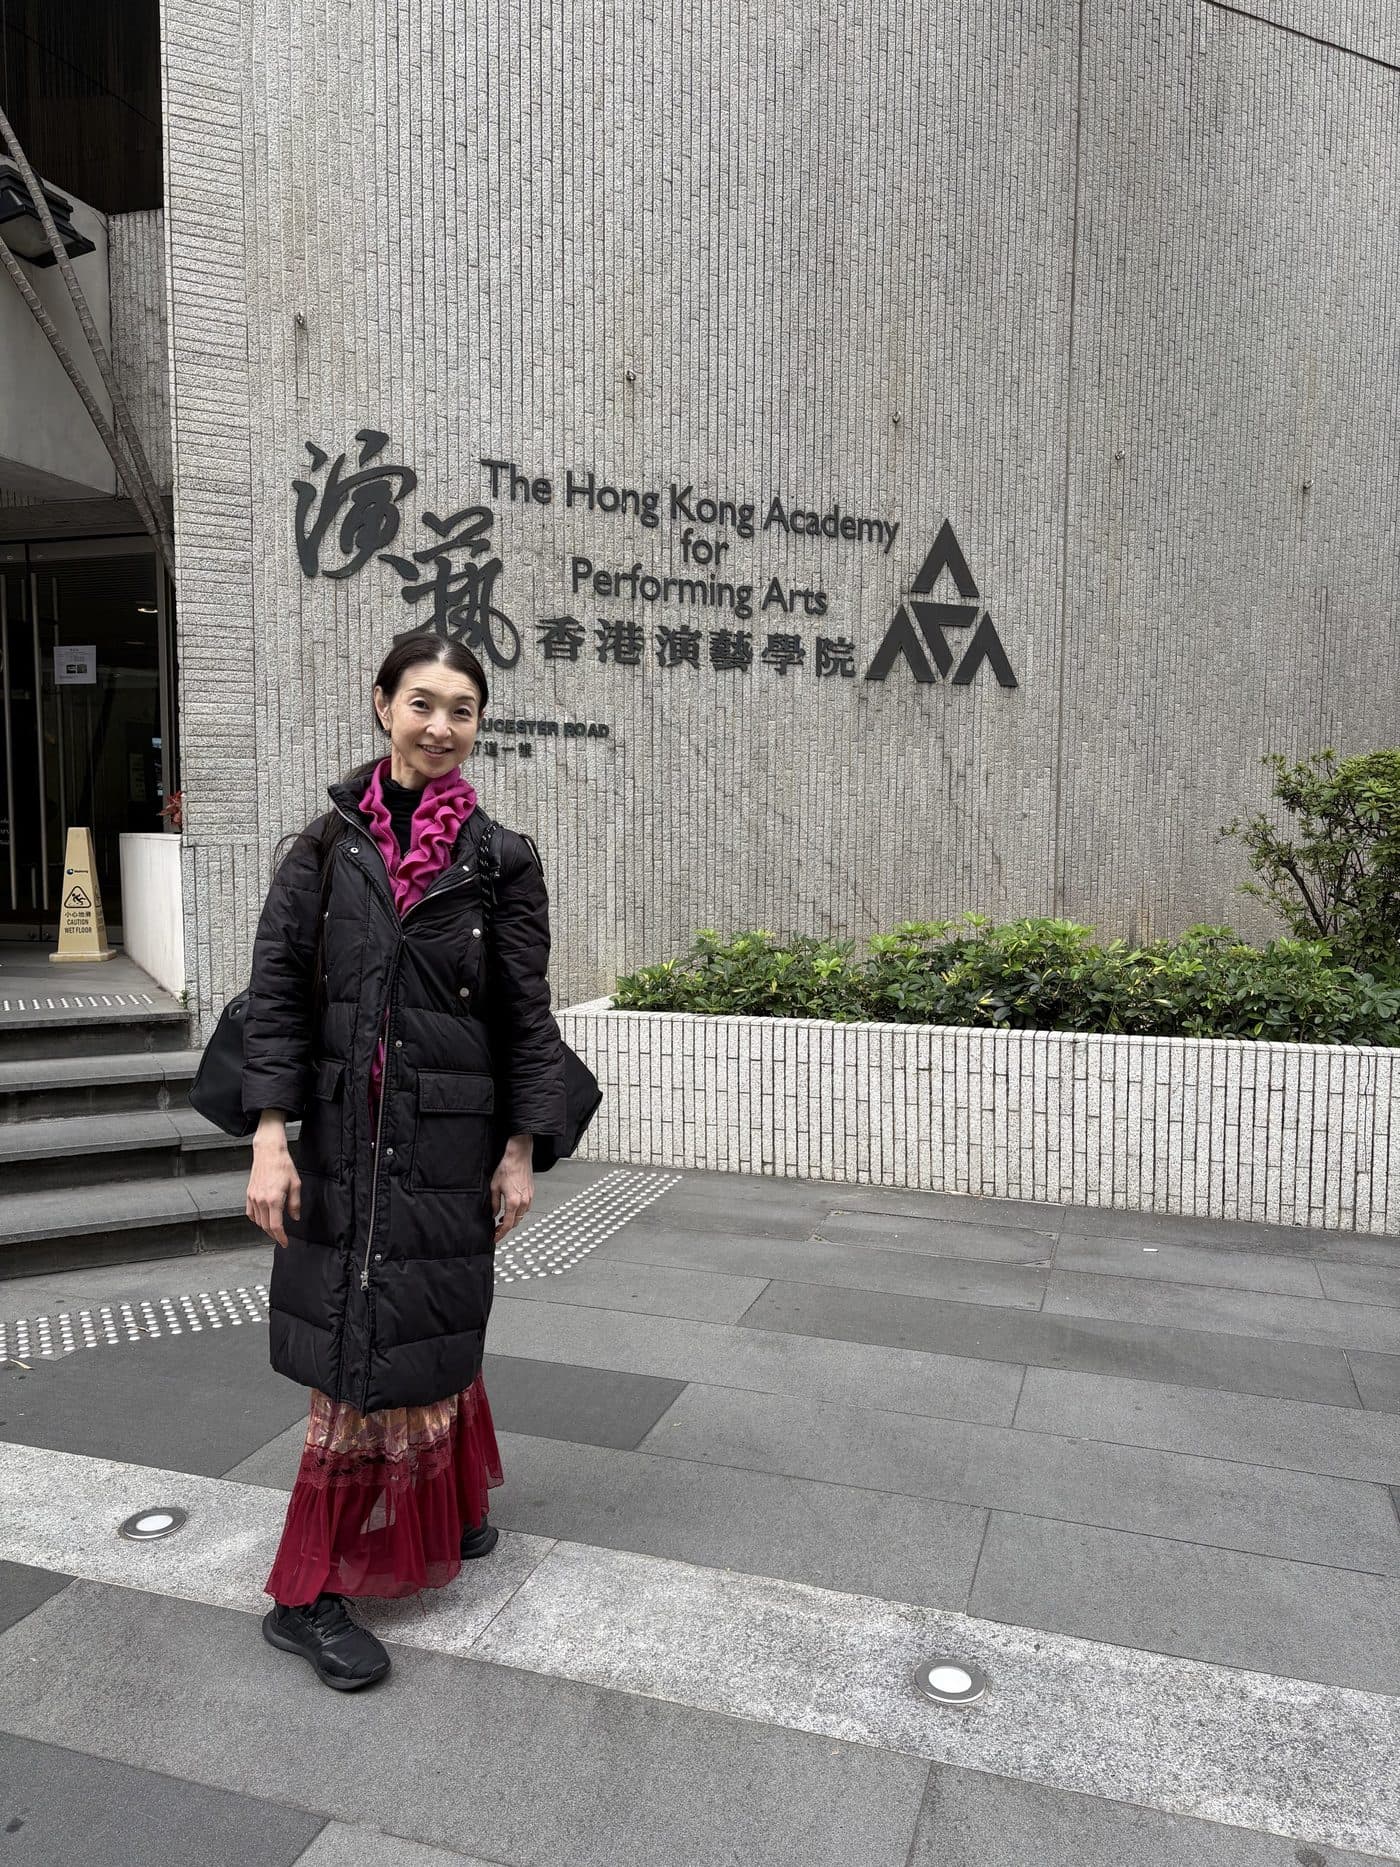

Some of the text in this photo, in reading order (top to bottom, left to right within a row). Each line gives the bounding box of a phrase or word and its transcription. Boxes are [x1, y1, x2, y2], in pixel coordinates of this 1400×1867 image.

[482, 458, 899, 554] The Hong Kong Academy
[680, 527, 729, 566] for
[571, 556, 828, 619] Performing Arts
[536, 615, 856, 678] 香港演藝學院
[480, 717, 610, 738] UCESTER ROAD
